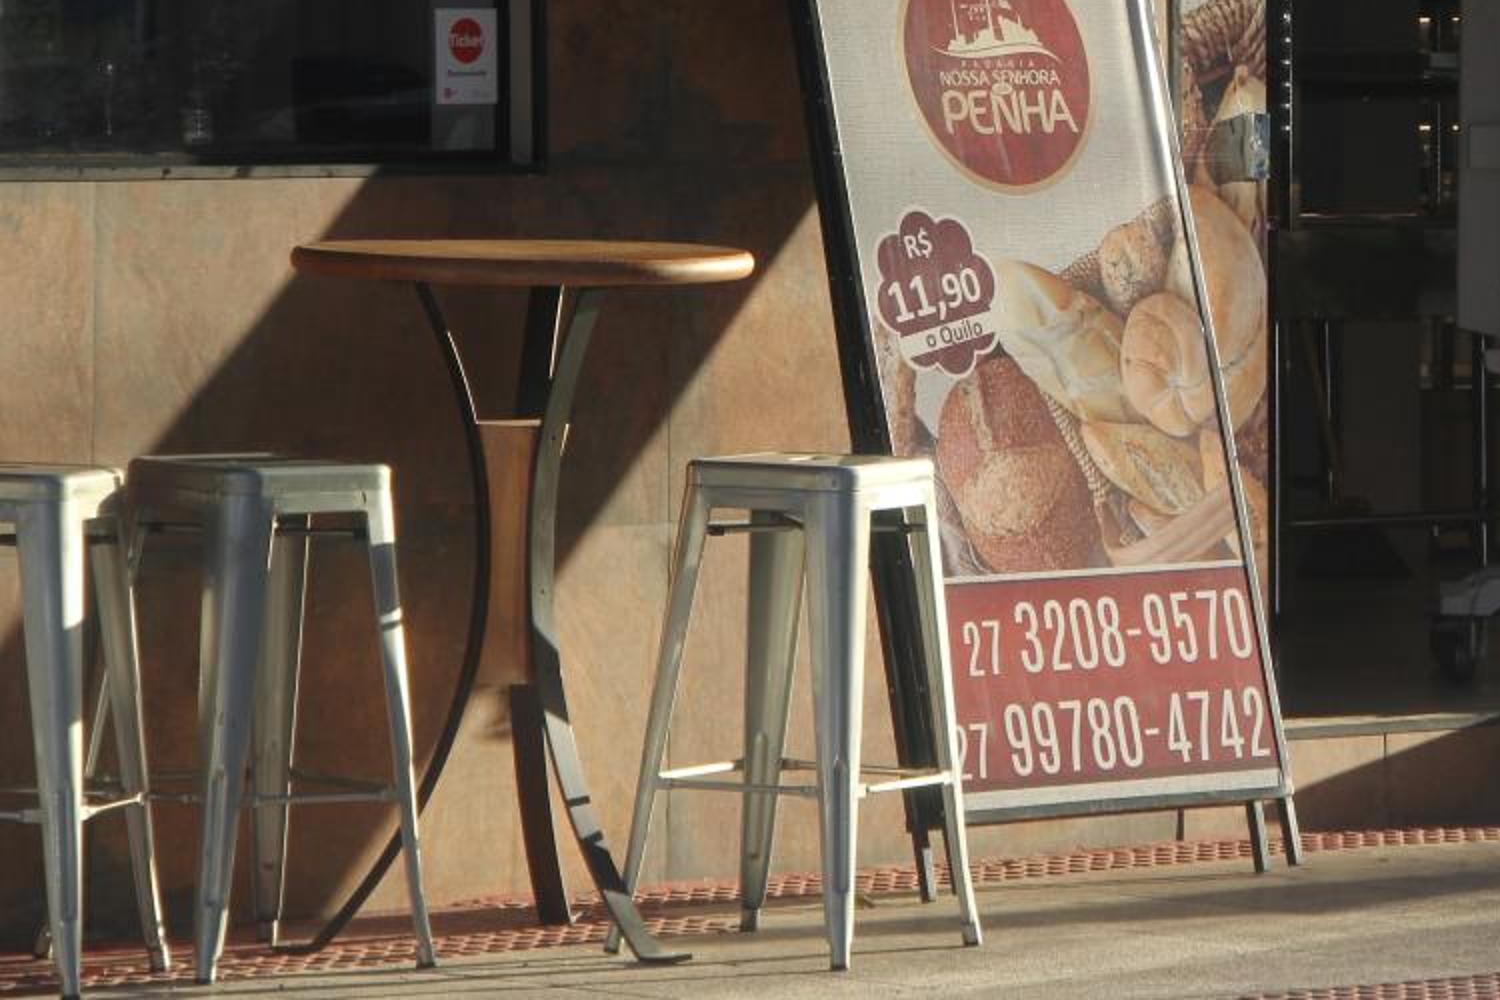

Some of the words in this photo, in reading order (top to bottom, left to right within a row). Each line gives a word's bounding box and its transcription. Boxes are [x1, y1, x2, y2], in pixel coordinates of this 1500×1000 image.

[940, 70, 990, 86] NOSSA
[991, 68, 1061, 85] SENHORA
[941, 87, 1079, 136] PENHA
[904, 227, 933, 259] R$
[887, 267, 981, 323] 11,90
[926, 334, 937, 348] o
[939, 318, 983, 345] Quilo
[963, 619, 1001, 678] 27
[1013, 587, 1253, 674] 3208-9570
[1003, 686, 1271, 777] 99780-4742
